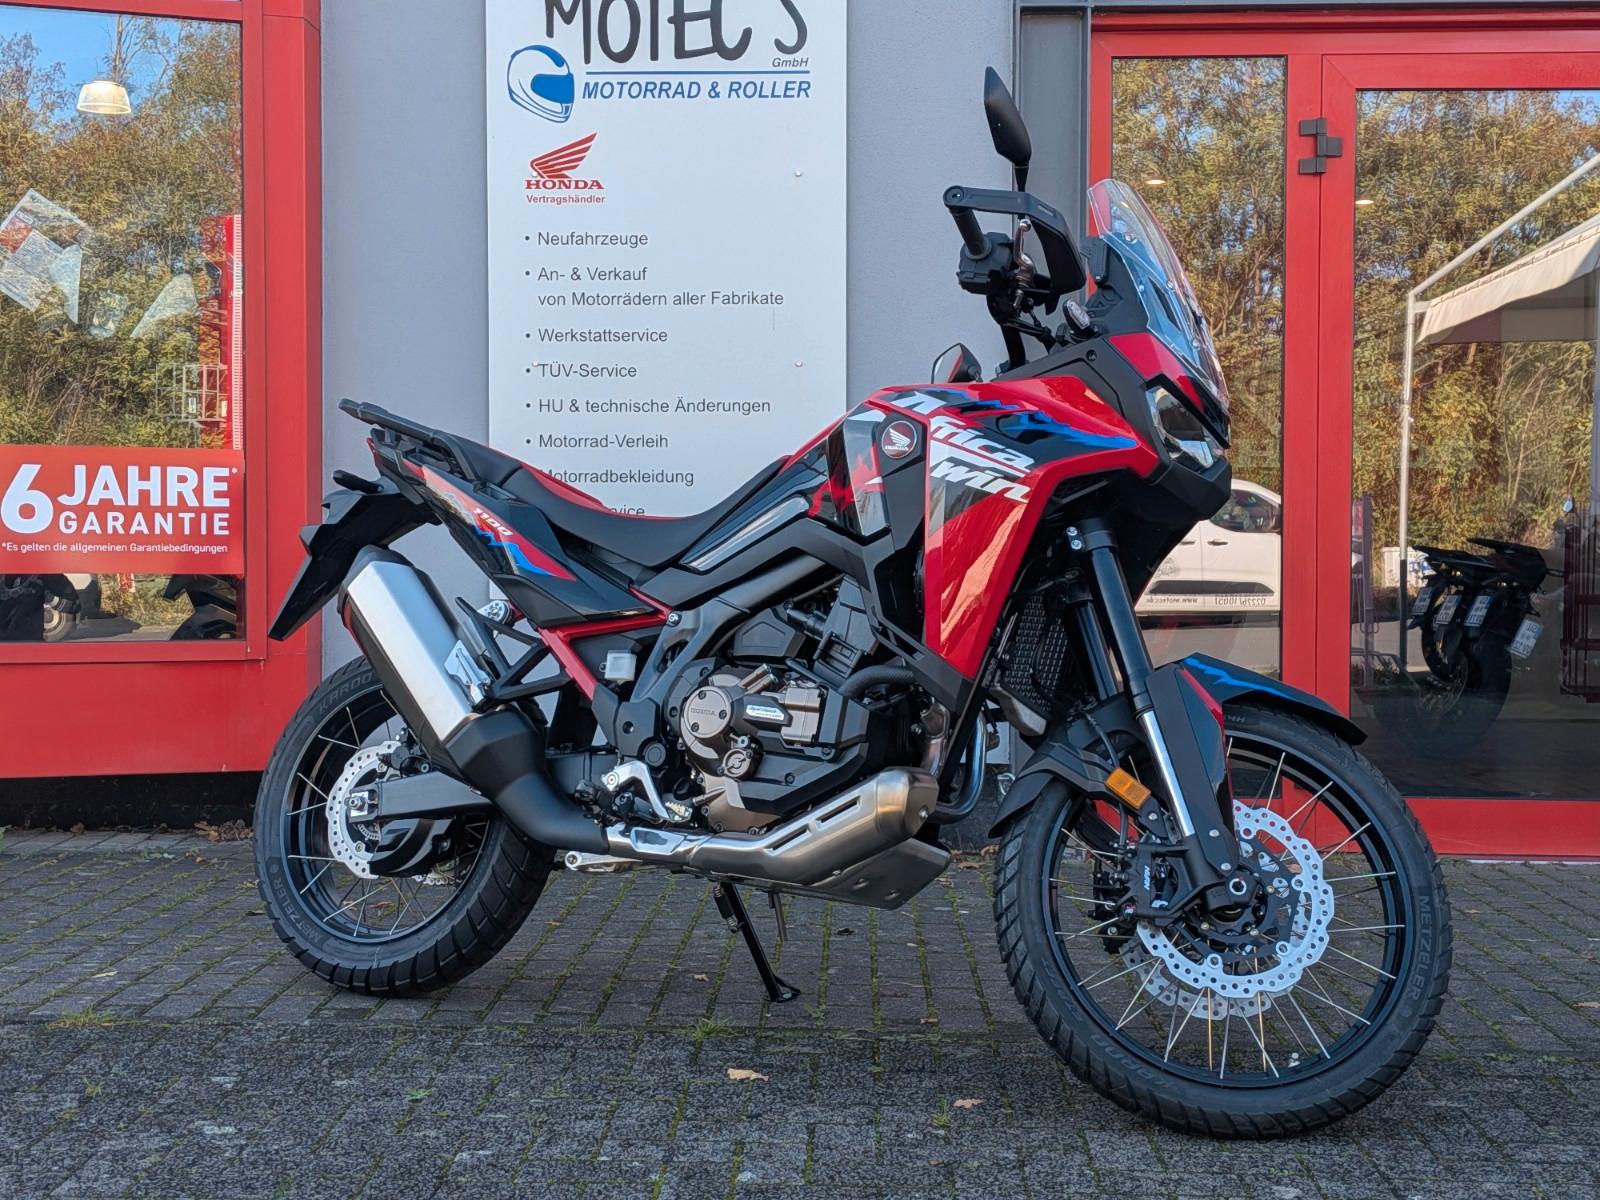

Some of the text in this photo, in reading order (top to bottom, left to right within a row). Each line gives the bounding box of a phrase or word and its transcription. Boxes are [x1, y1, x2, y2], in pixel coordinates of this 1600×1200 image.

[772, 57, 809, 67] GmbH
[582, 81, 811, 99] MOTORRAD & ROLLER
[525, 179, 605, 190] HONDA
[526, 195, 605, 205] Vertragshändler
[538, 232, 648, 248] Neufahrzeuge
[538, 267, 647, 281] An- & Verkauf
[538, 291, 784, 306] von Motorrädern aller Fabrikate
[538, 328, 667, 342] Werkstattservice
[537, 361, 637, 377] TÜV-Service
[539, 396, 770, 416] HU & technische Änderungen
[540, 434, 668, 448] Motorrad-Verleih
[0, 464, 53, 534] 6
[59, 511, 229, 535] GARANTIE
[21, 543, 51, 553] gelten
[54, 543, 67, 551] die
[70, 543, 127, 553] allgemeinen
[130, 543, 227, 554] Garantiebedingungen
[1408, 894, 1433, 1001] METZELER
